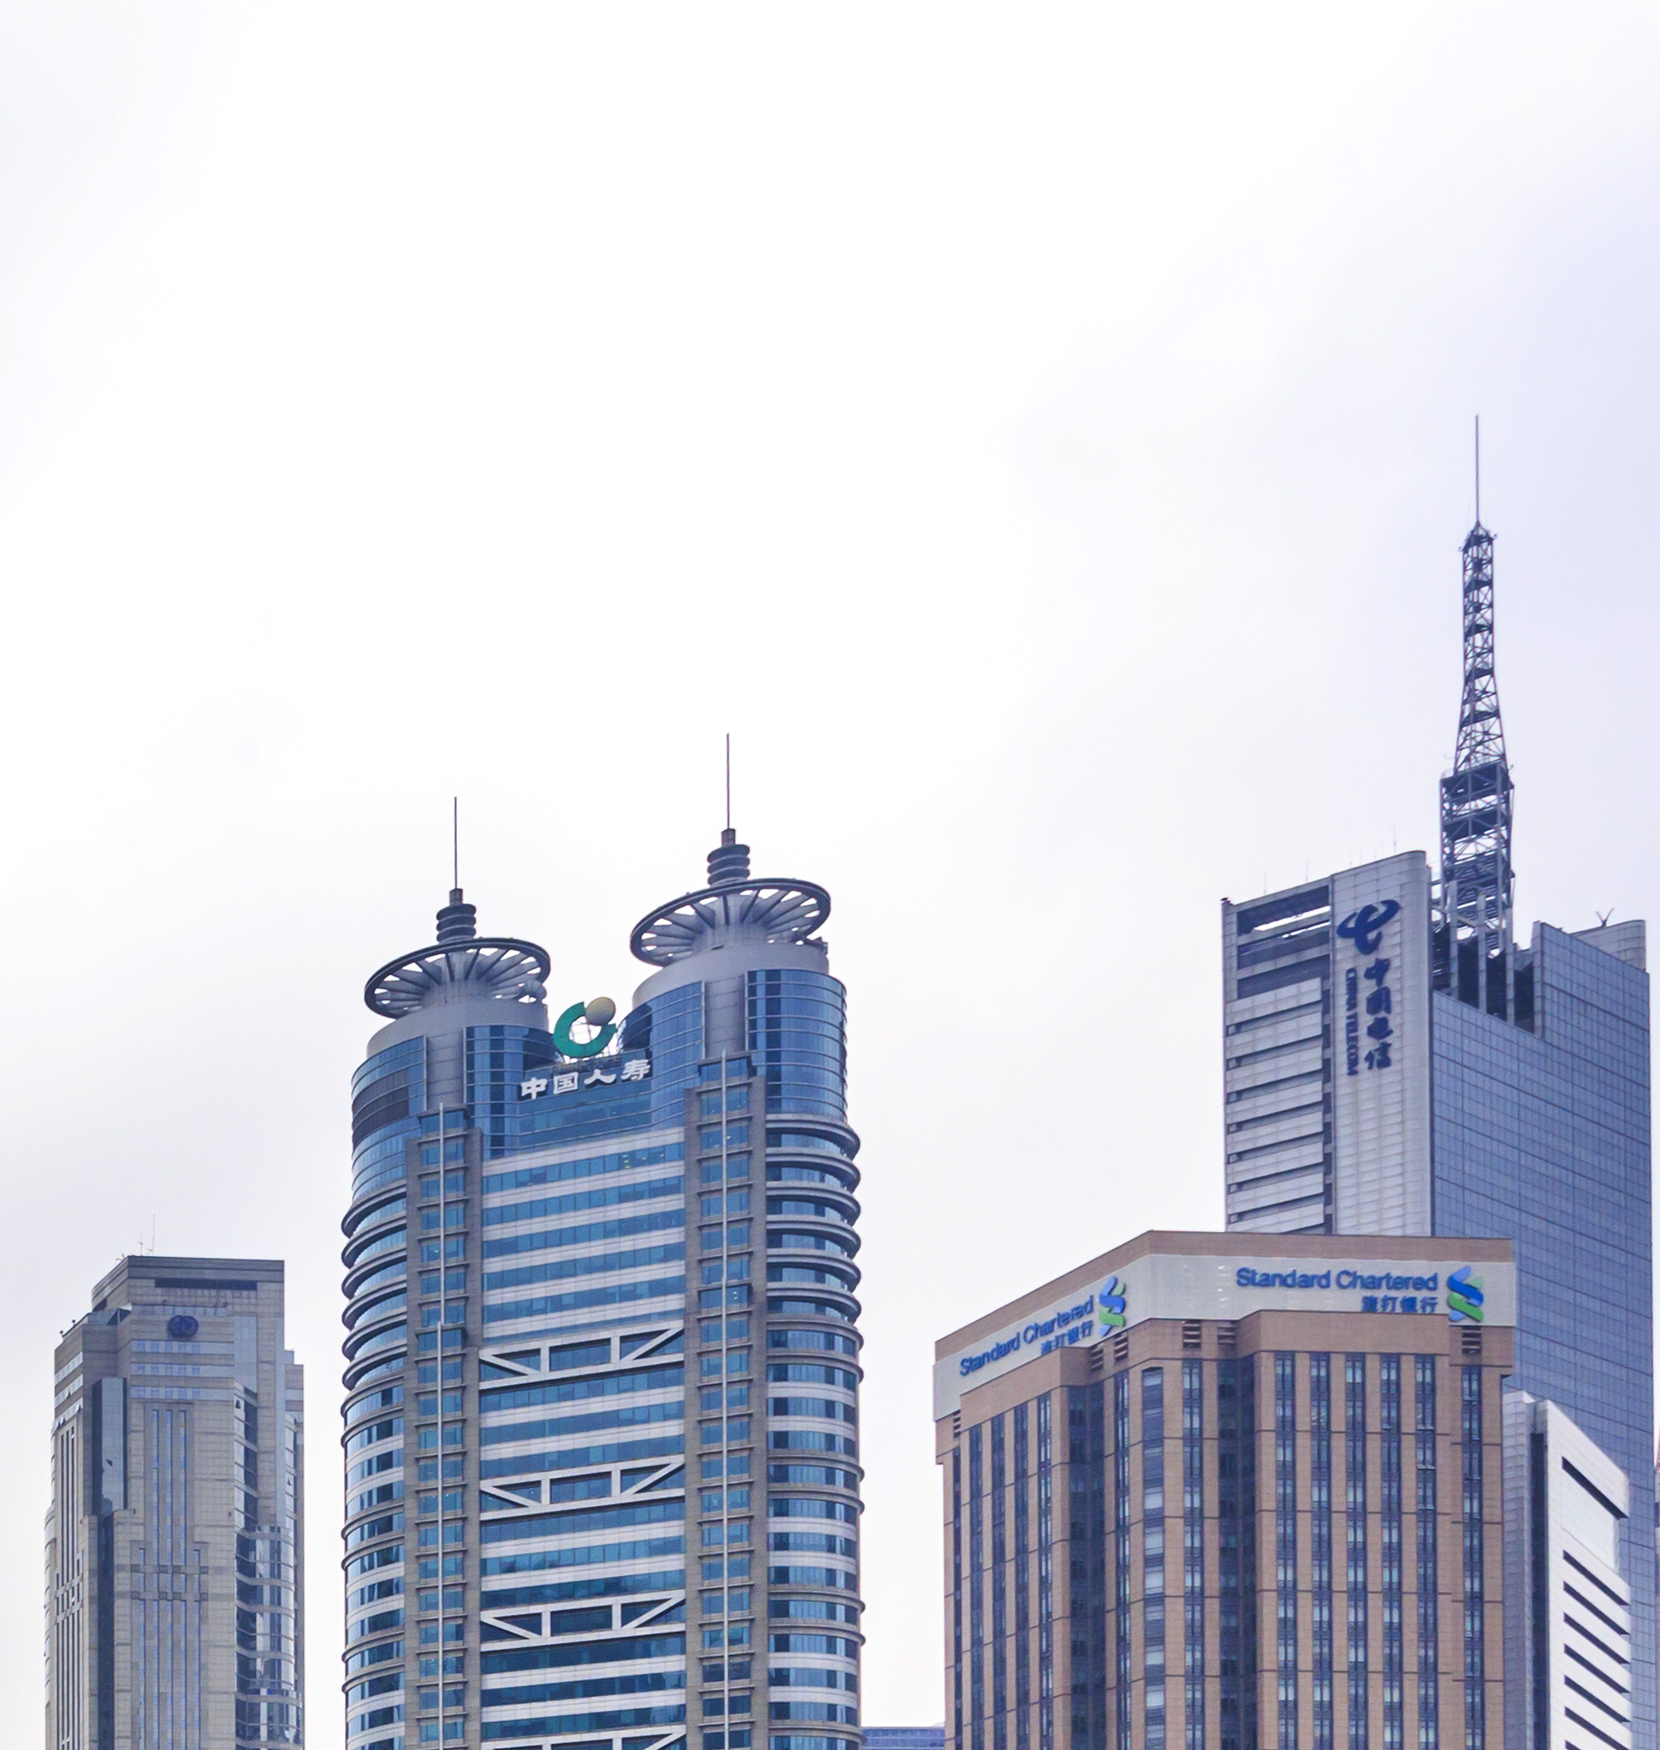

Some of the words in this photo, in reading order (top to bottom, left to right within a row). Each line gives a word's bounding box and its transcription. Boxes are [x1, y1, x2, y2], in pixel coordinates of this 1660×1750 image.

[520, 1058, 652, 1100] 中国人寿
[1235, 1267, 1331, 1289] Standard
[1336, 1269, 1439, 1291] Chartered
[1361, 1295, 1438, 1313] 渣打银行
[959, 1331, 1020, 1377] Standard
[1022, 1294, 1094, 1345] Chartered
[1040, 1319, 1094, 1356] 渣打银行
